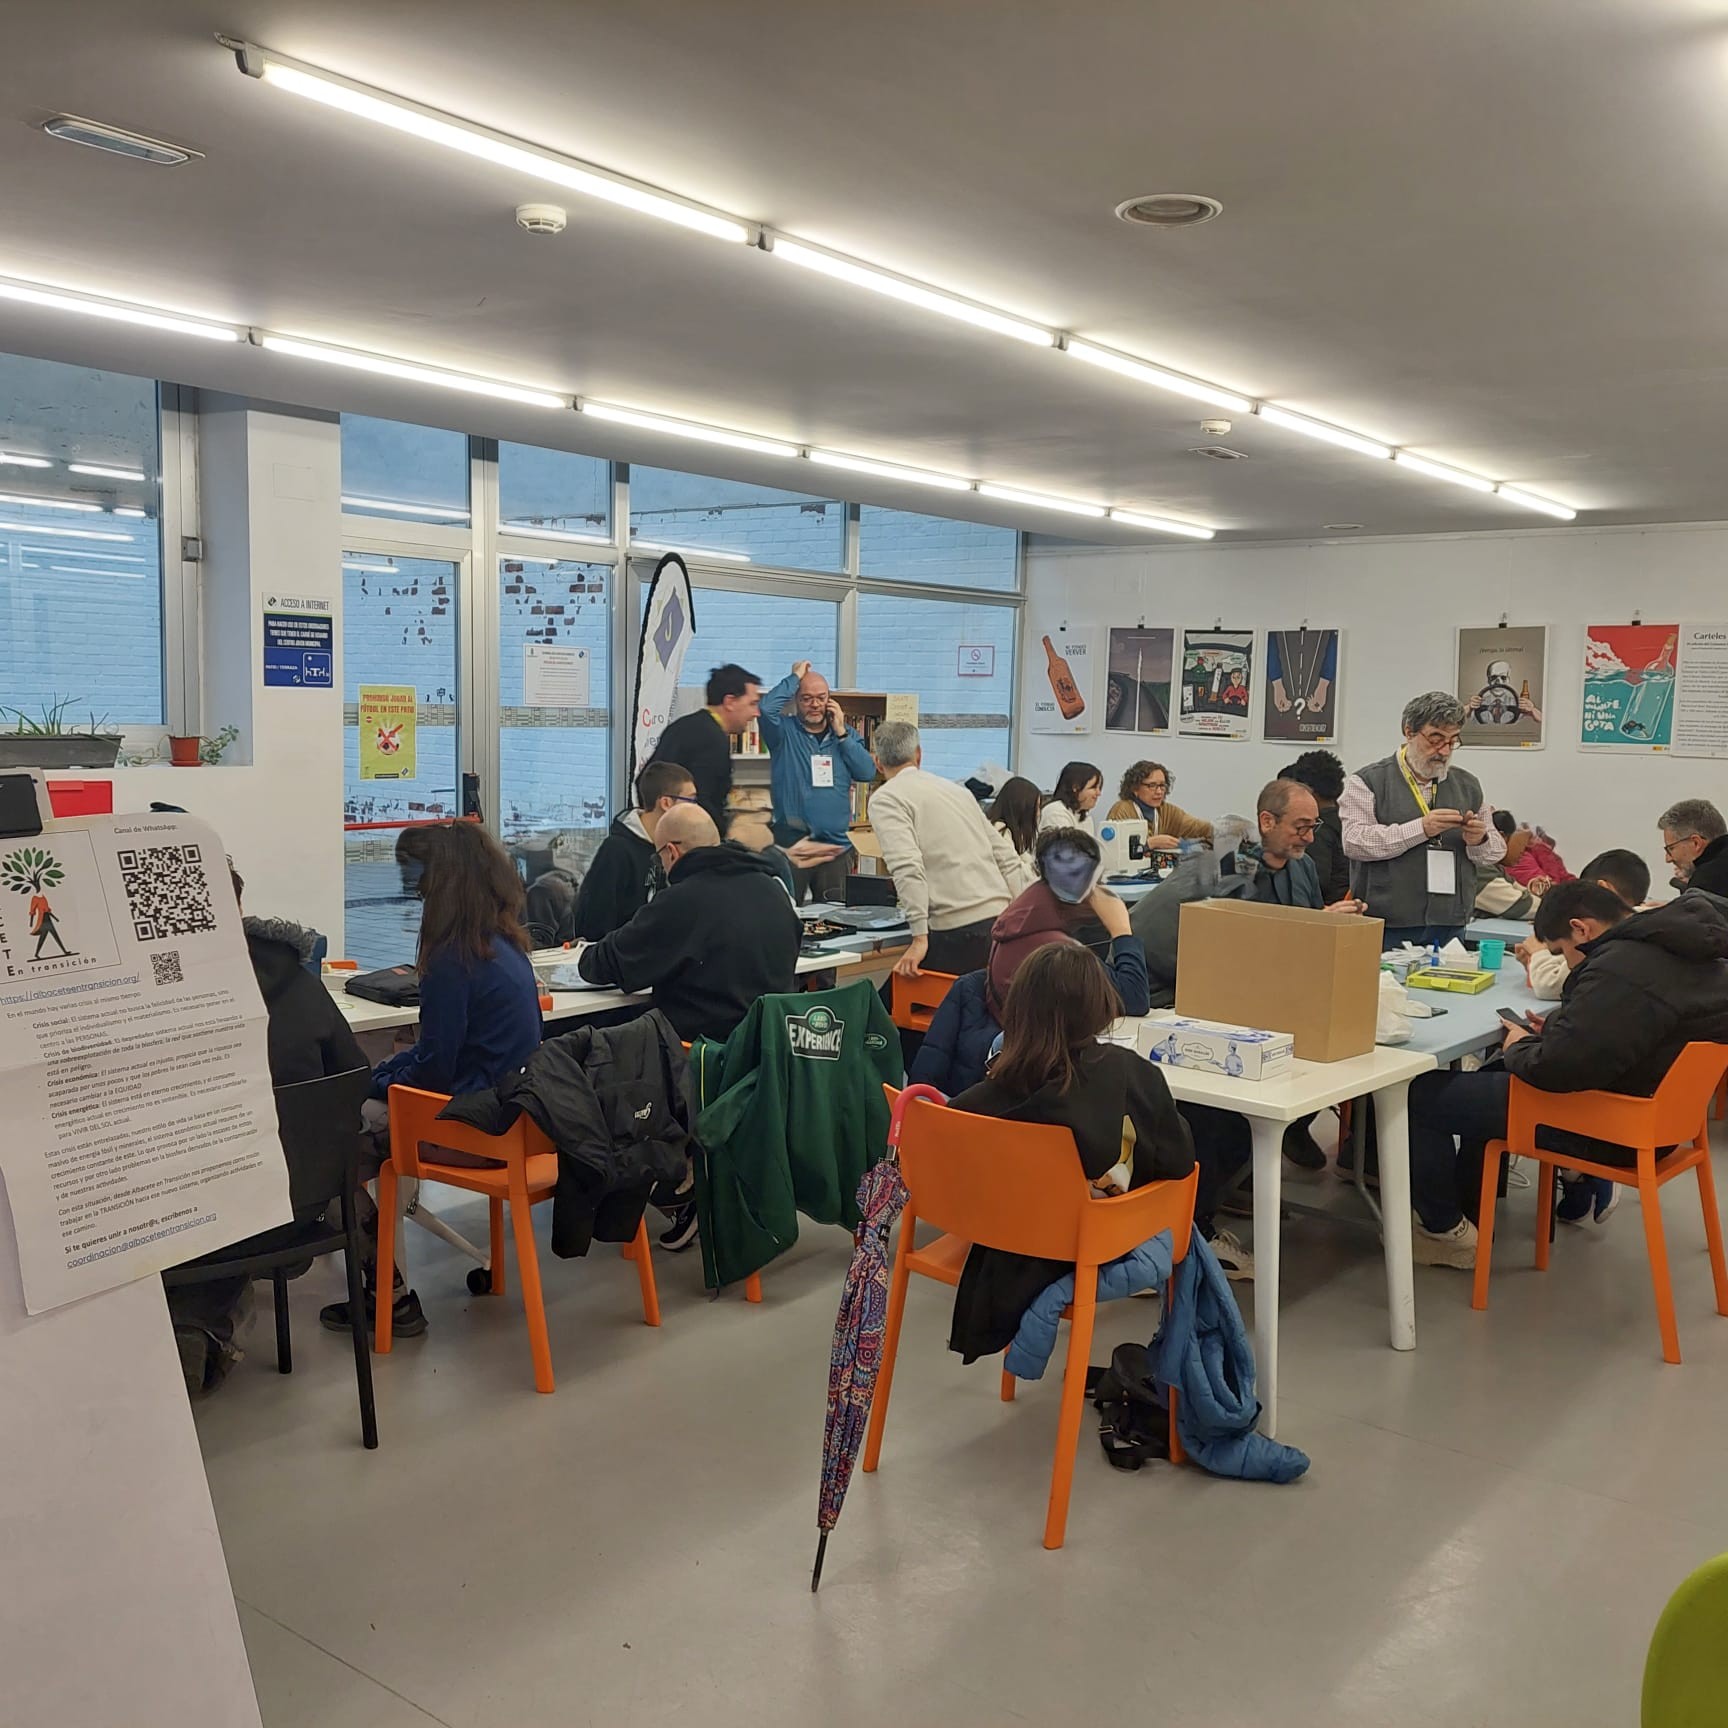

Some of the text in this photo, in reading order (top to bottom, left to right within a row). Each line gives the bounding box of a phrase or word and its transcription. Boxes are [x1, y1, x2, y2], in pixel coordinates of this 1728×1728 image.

[281, 599, 329, 610] ACCESO A INTERNET
[1694, 632, 1726, 640] Carteles
[363, 694, 389, 702] PROHIBIDO
[1585, 695, 1601, 703] AL
[361, 704, 378, 712] FÚTBOL
[1584, 711, 1595, 719] NI
[1584, 720, 1614, 731] GOTA
[31, 957, 97, 972] transición
[32, 1020, 49, 1029] Crisis
[43, 1049, 60, 1059] Crisis
[61, 1047, 69, 1055] de
[112, 1046, 119, 1054] de
[121, 1043, 133, 1052] toda
[47, 1067, 59, 1077] está
[47, 1077, 63, 1087] Crisis
[107, 1065, 129, 1075] sistema
[130, 1059, 147, 1070] actual
[79, 1084, 90, 1093] por
[91, 1080, 105, 1089] unos
[106, 1076, 124, 1087] pocos
[130, 1073, 140, 1082] que
[151, 1066, 168, 1077] pobres
[51, 1109, 67, 1119] Crisis
[130, 1091, 142, 1101] está
[151, 1086, 169, 1096] eterno
[79, 1091, 102, 1102] cambiar
[58, 1130, 71, 1140] para
[72, 1124, 88, 1135] VIVIR
[44, 1140, 92, 1158] Estas crisis están
[47, 1149, 100, 1169] masivo de energía
[50, 1164, 85, 1179] crecimiento
[86, 1156, 113, 1169] constante
[115, 1154, 122, 1162] de
[145, 1146, 155, 1155] que
[156, 1140, 177, 1152] provoca
[53, 1178, 78, 1190] recursos
[84, 1173, 94, 1182] por
[95, 1169, 107, 1178] otro
[109, 1165, 121, 1174] lado
[122, 1157, 150, 1172] problemas
[58, 1207, 70, 1216] Con
[71, 1202, 83, 1212] esta
[113, 1189, 130, 1200] desde
[131, 1181, 155, 1194] Albacete
[156, 1179, 163, 1187] en
[60, 1191, 68, 1199] de
[69, 1184, 94, 1197] nuestras
[59, 1214, 83, 1227] trabajar
[93, 1209, 98, 1217] la
[99, 1197, 134, 1215] TRANSICIÓN
[135, 1193, 149, 1204] hacia
[150, 1191, 160, 1199] ese
[161, 1185, 177, 1196] nuevo
[61, 1229, 72, 1237] ese
[64, 1245, 71, 1254] Si
[73, 1243, 80, 1251] te
[81, 1235, 106, 1250] quieres
[108, 1229, 121, 1240] unir
